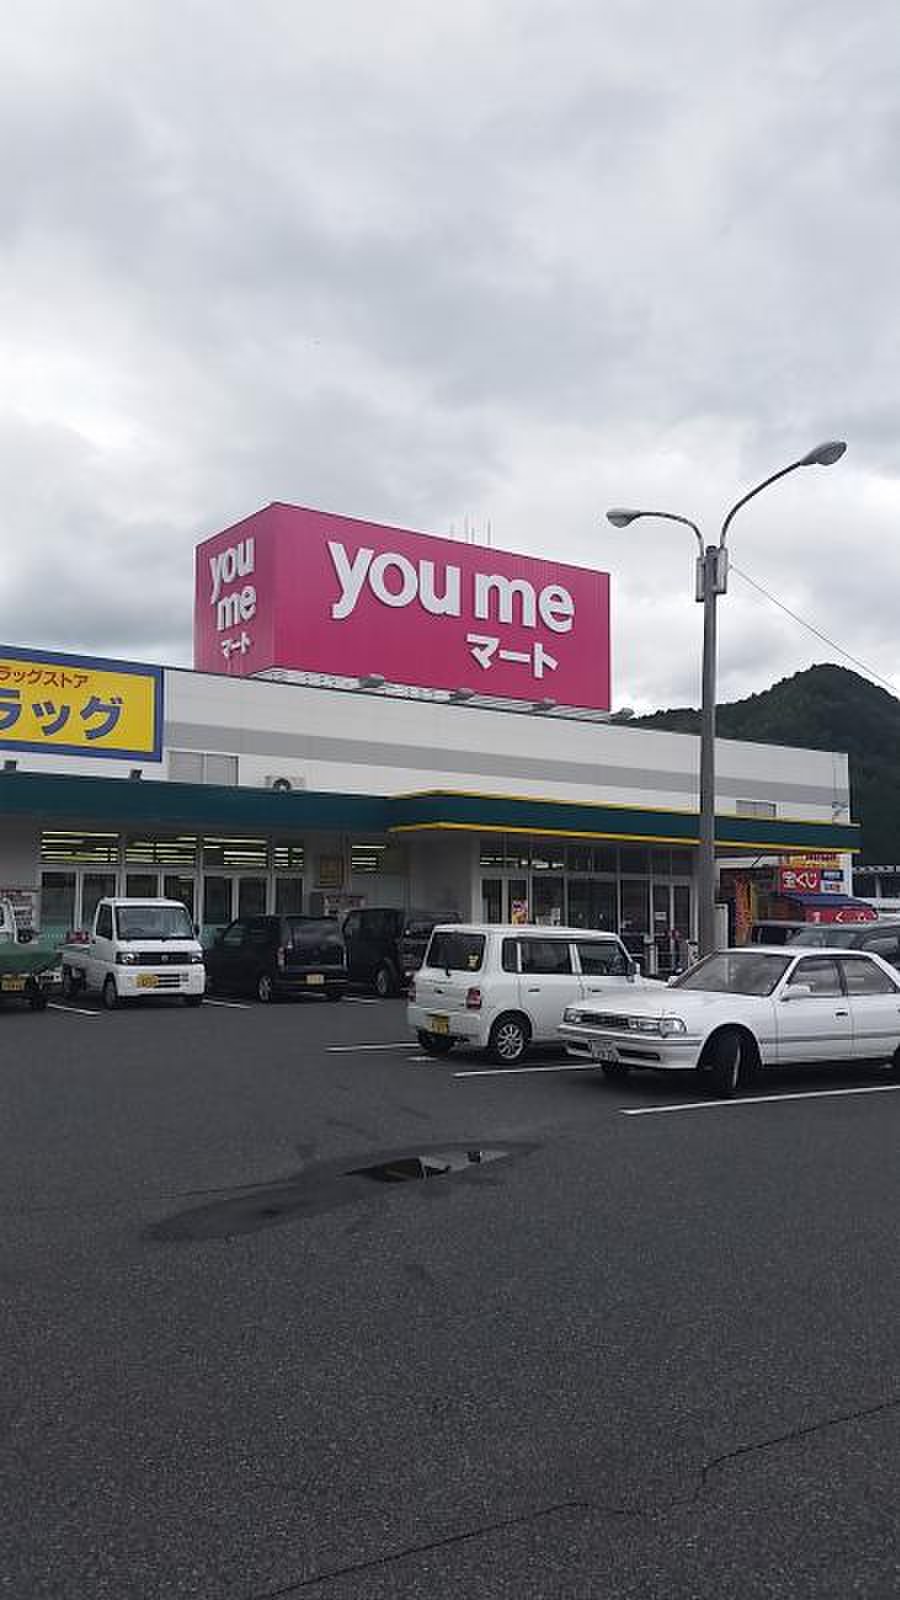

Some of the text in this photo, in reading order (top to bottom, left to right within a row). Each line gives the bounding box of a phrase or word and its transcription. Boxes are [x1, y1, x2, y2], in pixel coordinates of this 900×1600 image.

[208, 538, 255, 605] you
[328, 541, 575, 634] you me
[216, 585, 257, 632] me
[220, 632, 252, 660] マート
[465, 632, 559, 680] マート
